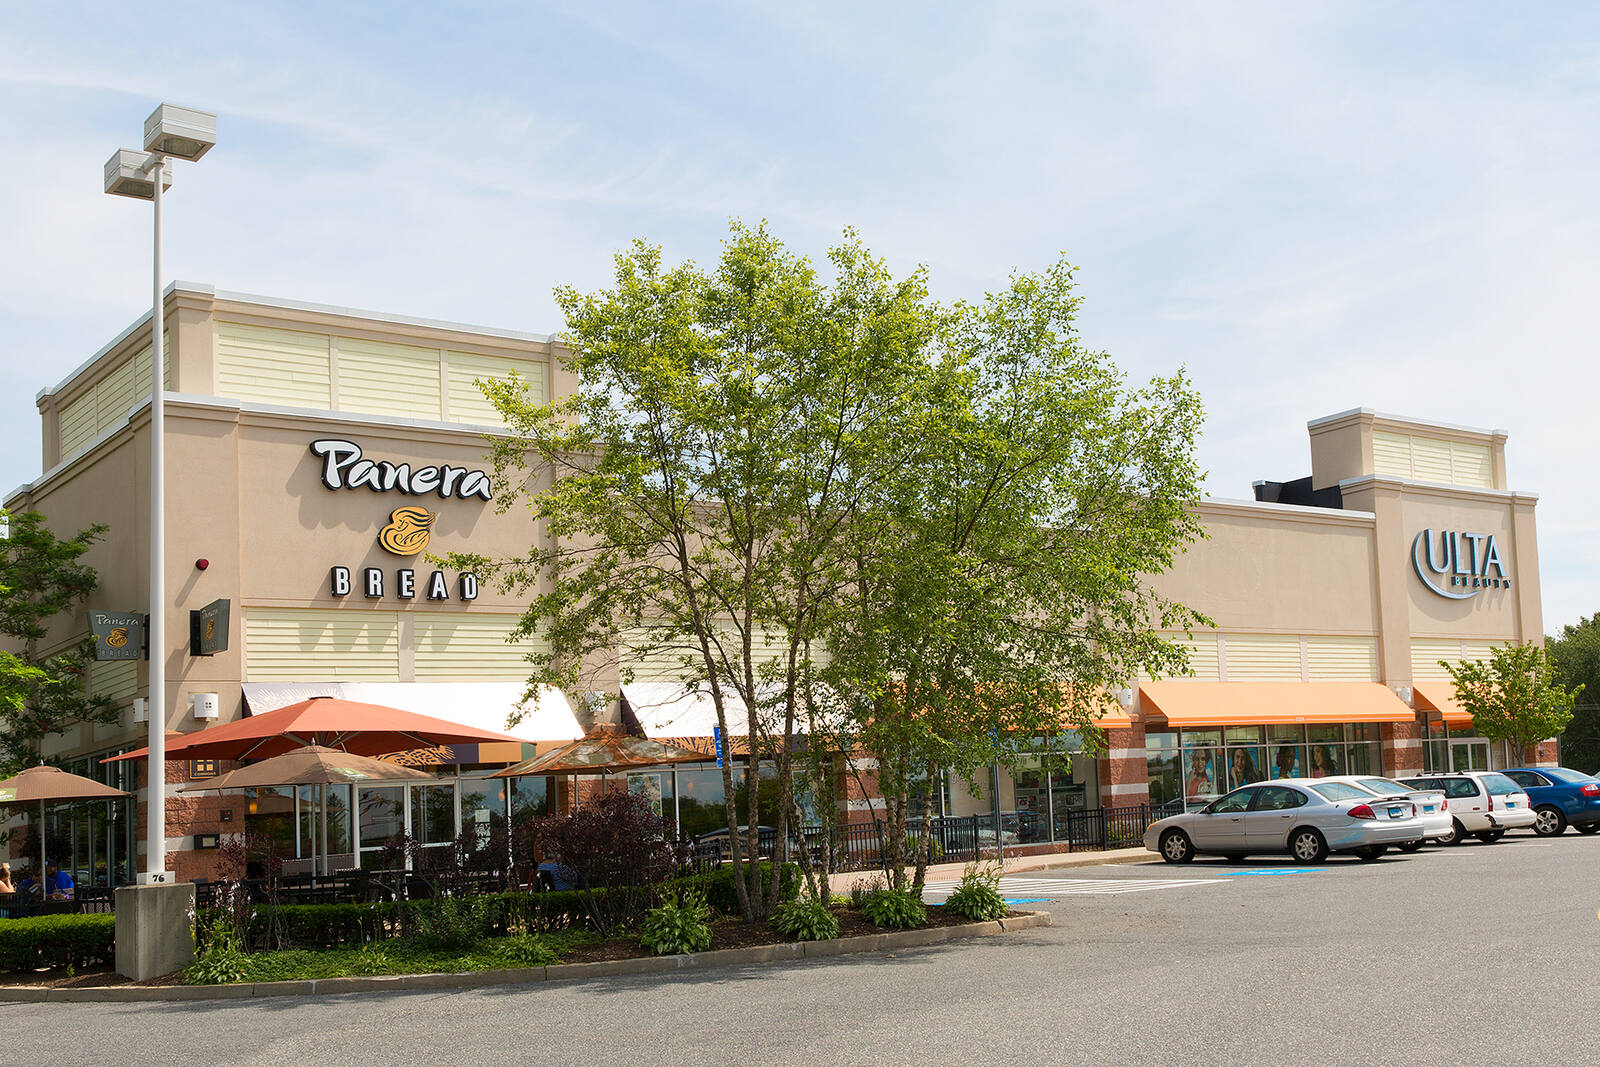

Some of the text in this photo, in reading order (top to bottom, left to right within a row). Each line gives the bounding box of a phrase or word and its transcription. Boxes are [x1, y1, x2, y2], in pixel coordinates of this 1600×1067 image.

[310, 439, 493, 501] Panera
[1424, 529, 1507, 577] ULTA
[331, 566, 479, 600] BREAD
[95, 614, 139, 626] Panera
[152, 874, 165, 882] 76
